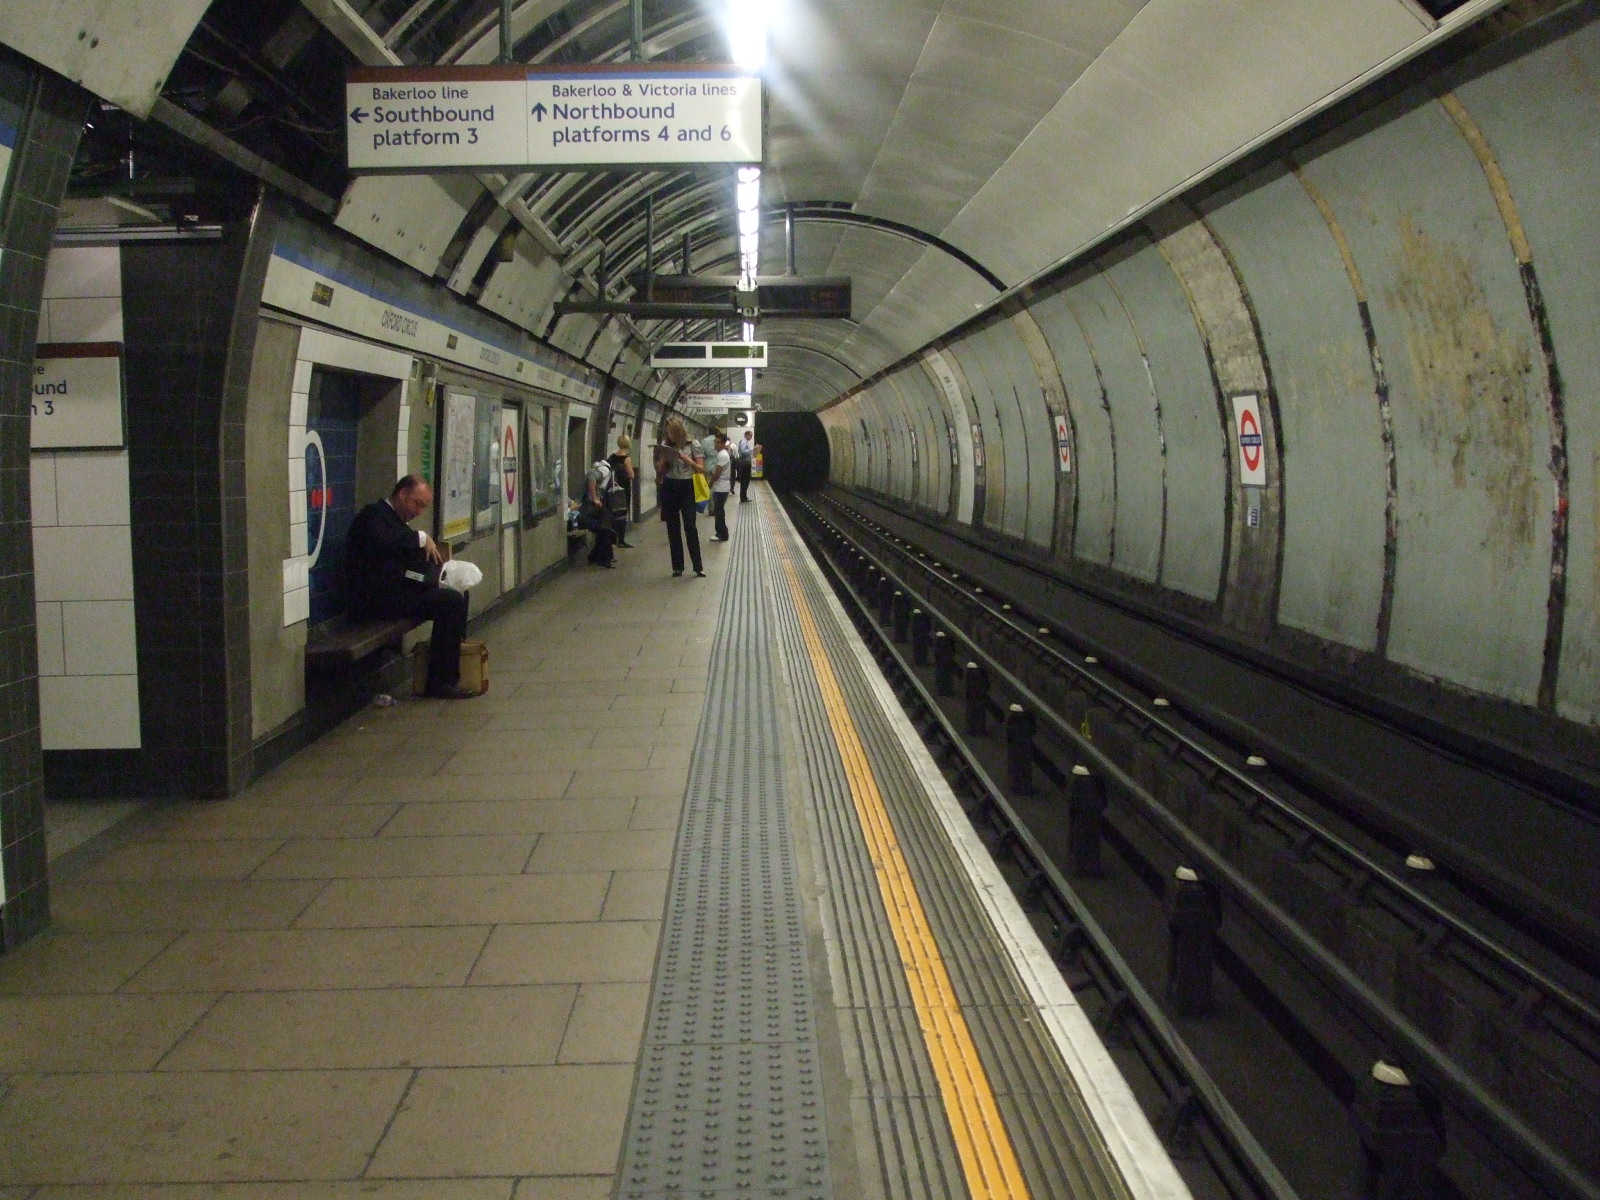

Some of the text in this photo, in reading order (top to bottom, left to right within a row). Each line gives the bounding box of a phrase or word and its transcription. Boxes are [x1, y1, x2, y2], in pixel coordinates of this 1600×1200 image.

[372, 86, 469, 100] Bakerloo line
[552, 83, 737, 97] Bakerloo & Victoria lines
[374, 105, 495, 123] Southbound
[553, 102, 675, 120] Northbound
[373, 127, 478, 149] platform 3
[553, 125, 732, 147] platforms 4 and 6
[44, 401, 54, 415] 3
